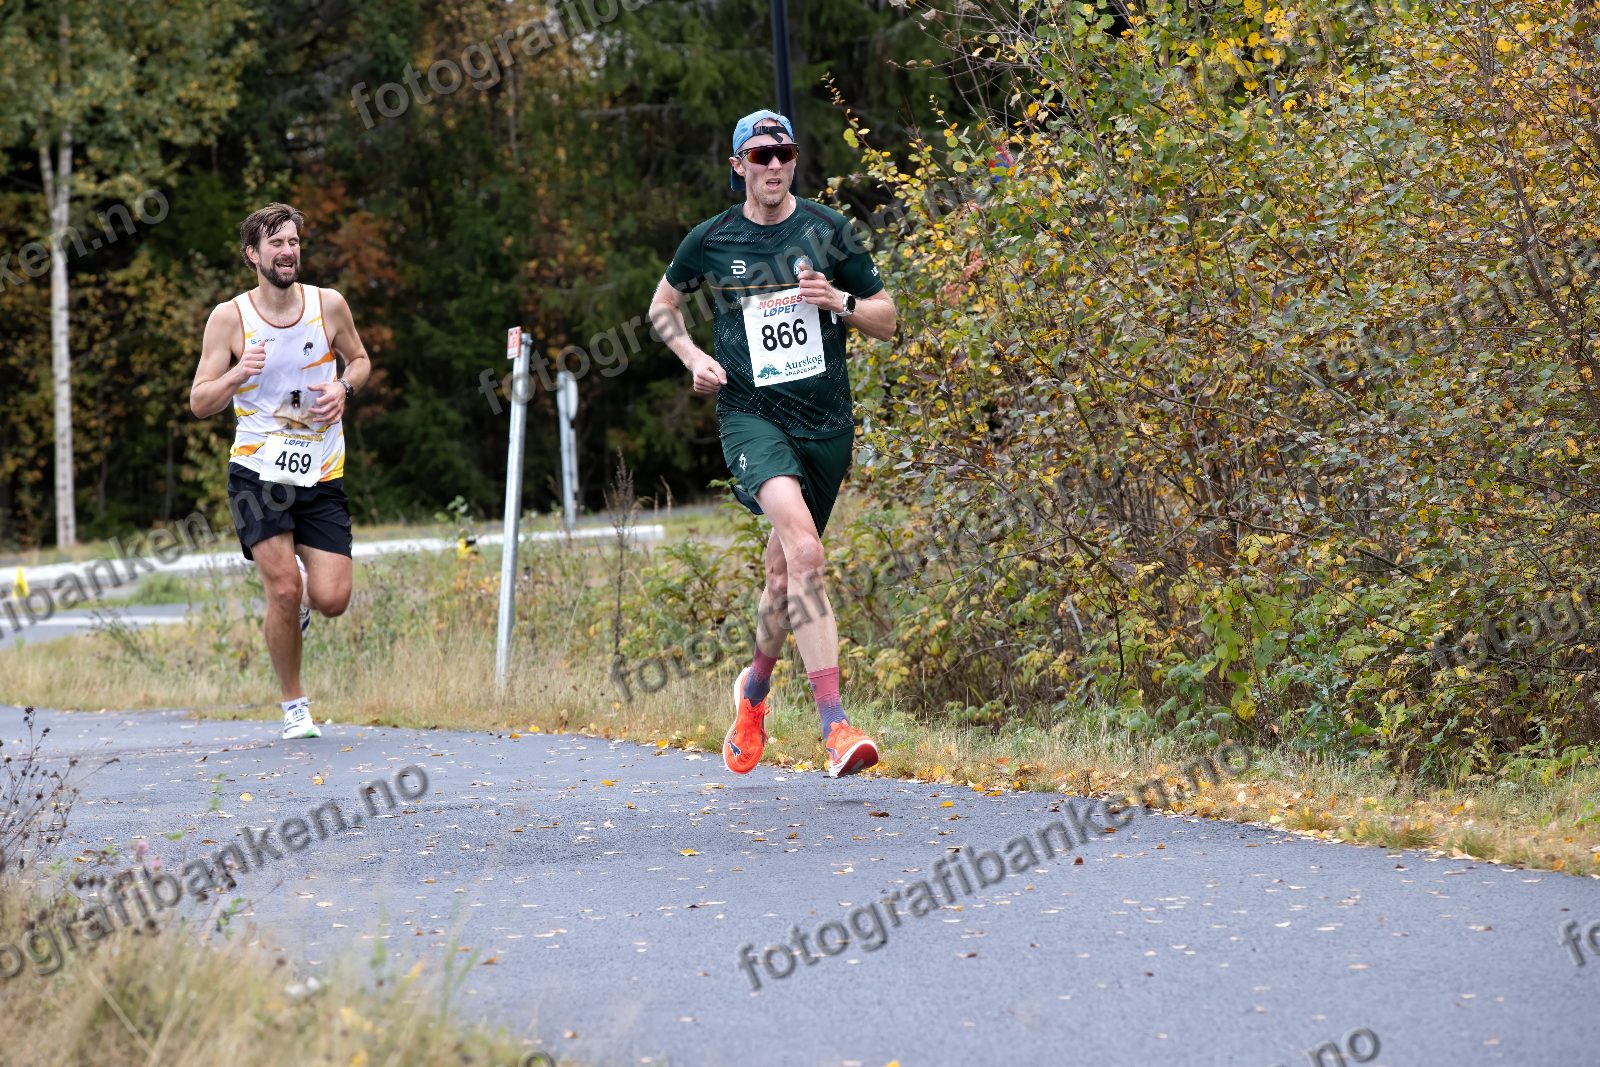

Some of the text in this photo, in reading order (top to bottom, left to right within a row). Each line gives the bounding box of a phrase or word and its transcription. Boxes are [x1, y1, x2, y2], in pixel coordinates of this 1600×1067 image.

[758, 294, 803, 309] NORGES
[763, 304, 797, 317] LØPET
[761, 318, 807, 351] 866
[784, 354, 823, 370] Aurskog
[283, 438, 311, 448] LØPET
[275, 451, 312, 474] 469
